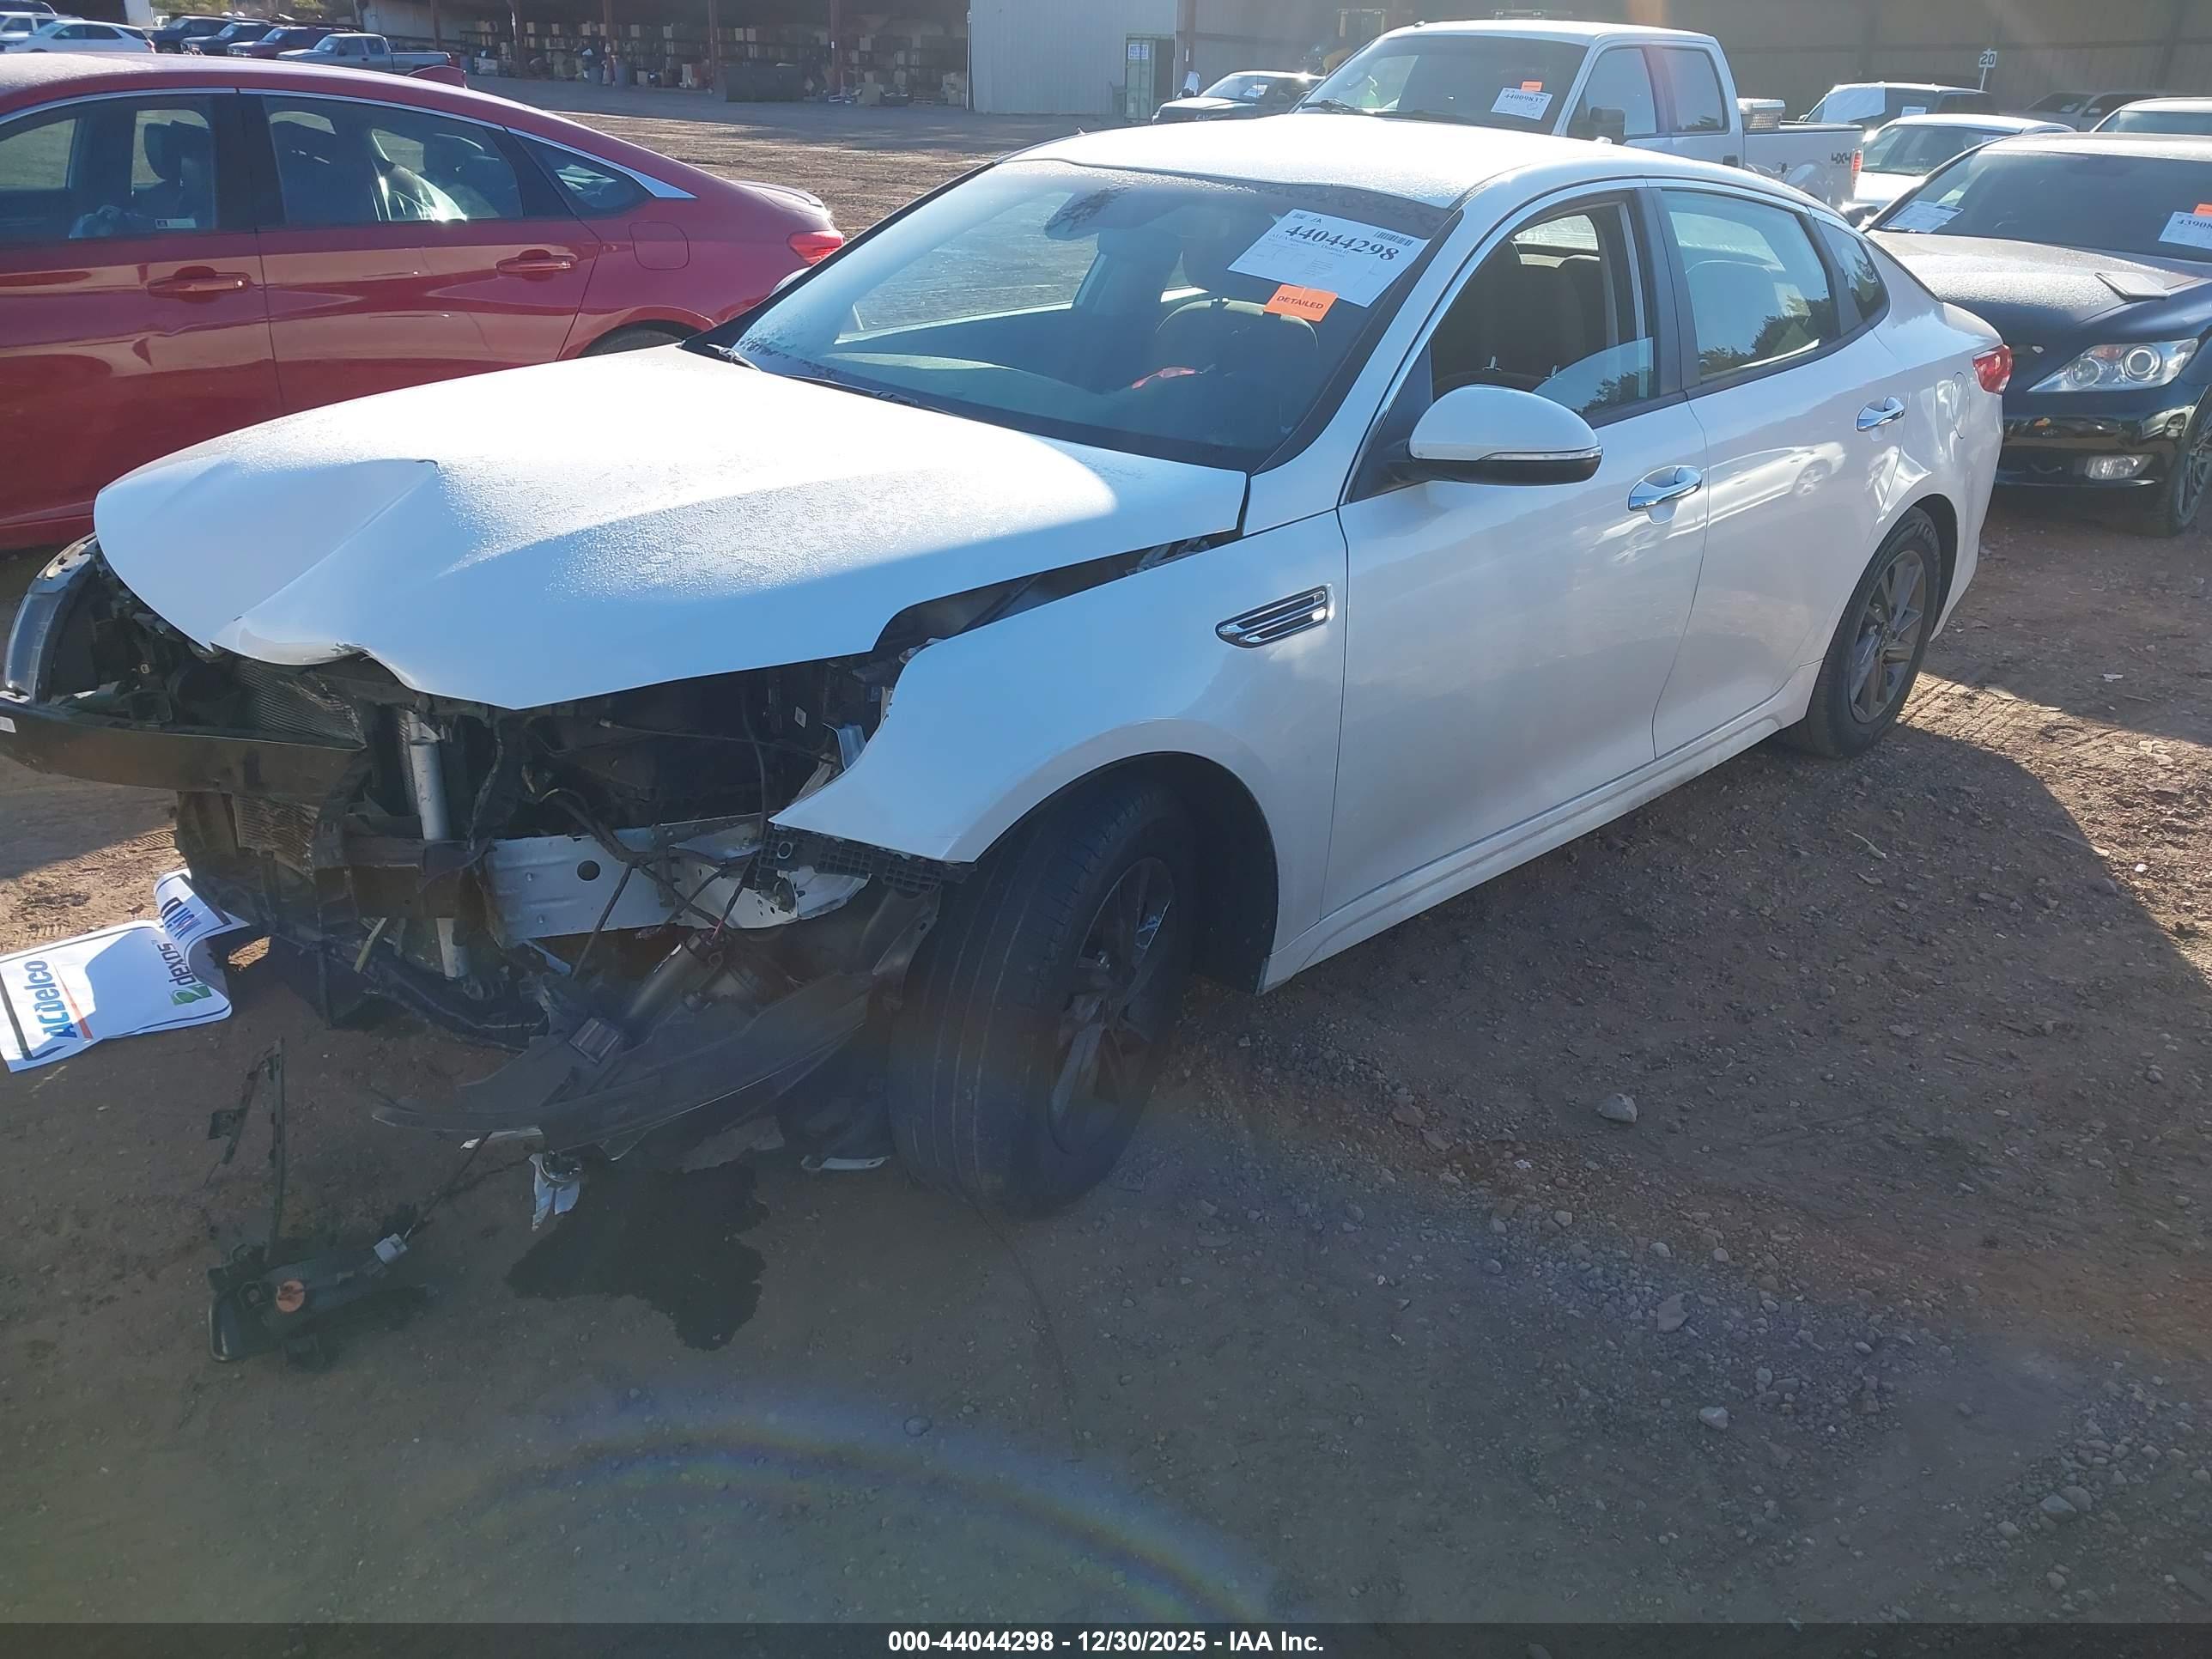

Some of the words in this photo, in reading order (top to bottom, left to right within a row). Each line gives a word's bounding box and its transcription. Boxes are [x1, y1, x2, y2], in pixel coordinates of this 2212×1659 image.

[1979, 53, 1995, 64] 20
[1285, 225, 1401, 261] 44044298
[1277, 295, 1324, 309] DETAILED
[157, 943, 197, 986] dexos
[24, 960, 78, 1039] ACDelco
